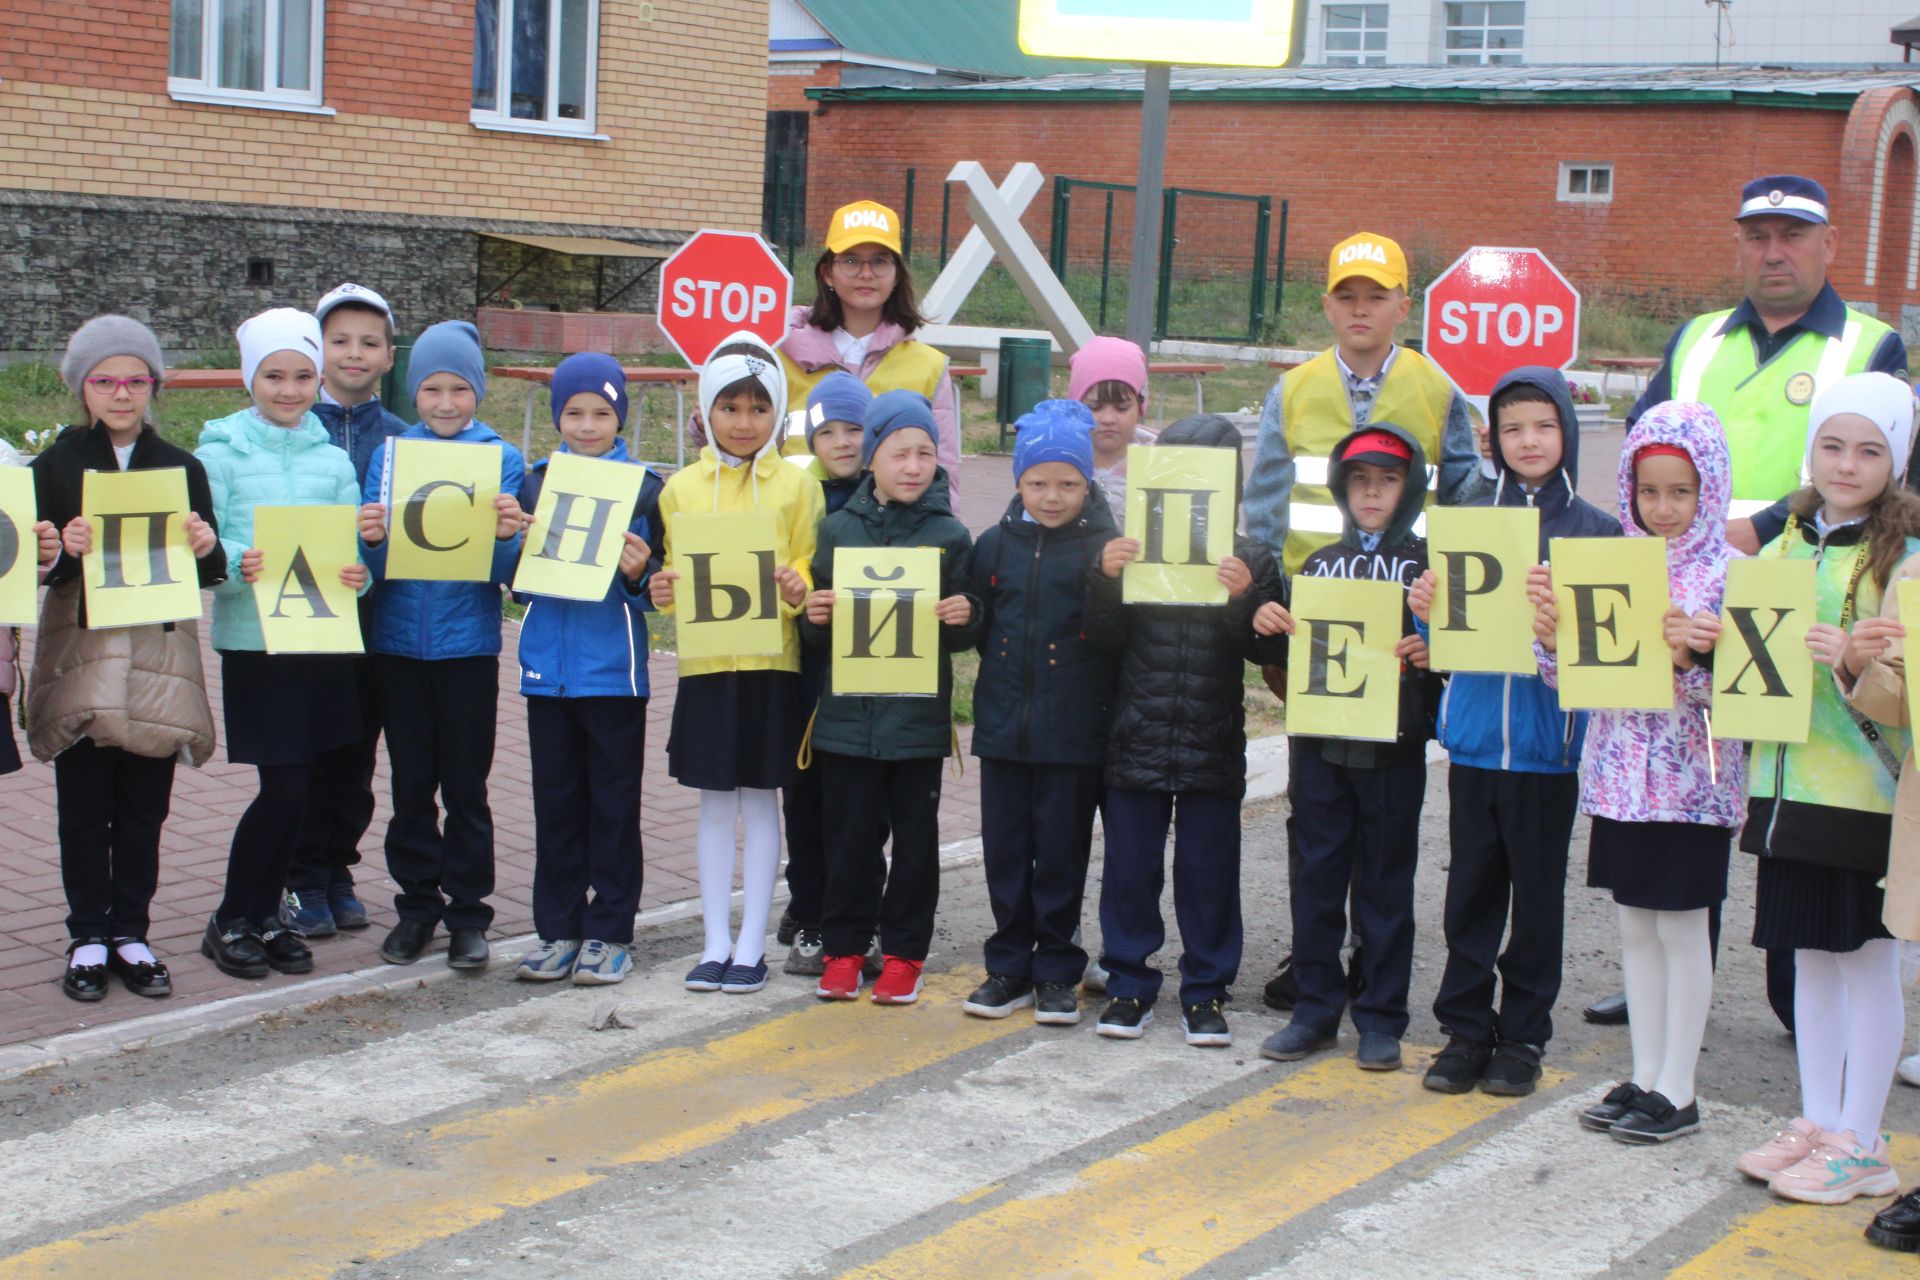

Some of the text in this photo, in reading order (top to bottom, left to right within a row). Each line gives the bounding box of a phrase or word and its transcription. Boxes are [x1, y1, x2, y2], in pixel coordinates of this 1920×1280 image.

[843, 209, 890, 232] ЮИД
[1338, 242, 1387, 267] ЮИД
[671, 277, 778, 324] STOP
[1439, 300, 1565, 347] STOP
[95, 510, 179, 588] П
[403, 480, 475, 552] С
[530, 490, 620, 568] Н
[1135, 487, 1219, 566] П
[269, 544, 339, 618] А
[682, 550, 778, 624] Ы
[842, 566, 924, 659] Й
[1437, 550, 1503, 632] Р
[1298, 618, 1368, 699] Е
[1564, 583, 1640, 667] Е
[1720, 606, 1794, 698] Х
